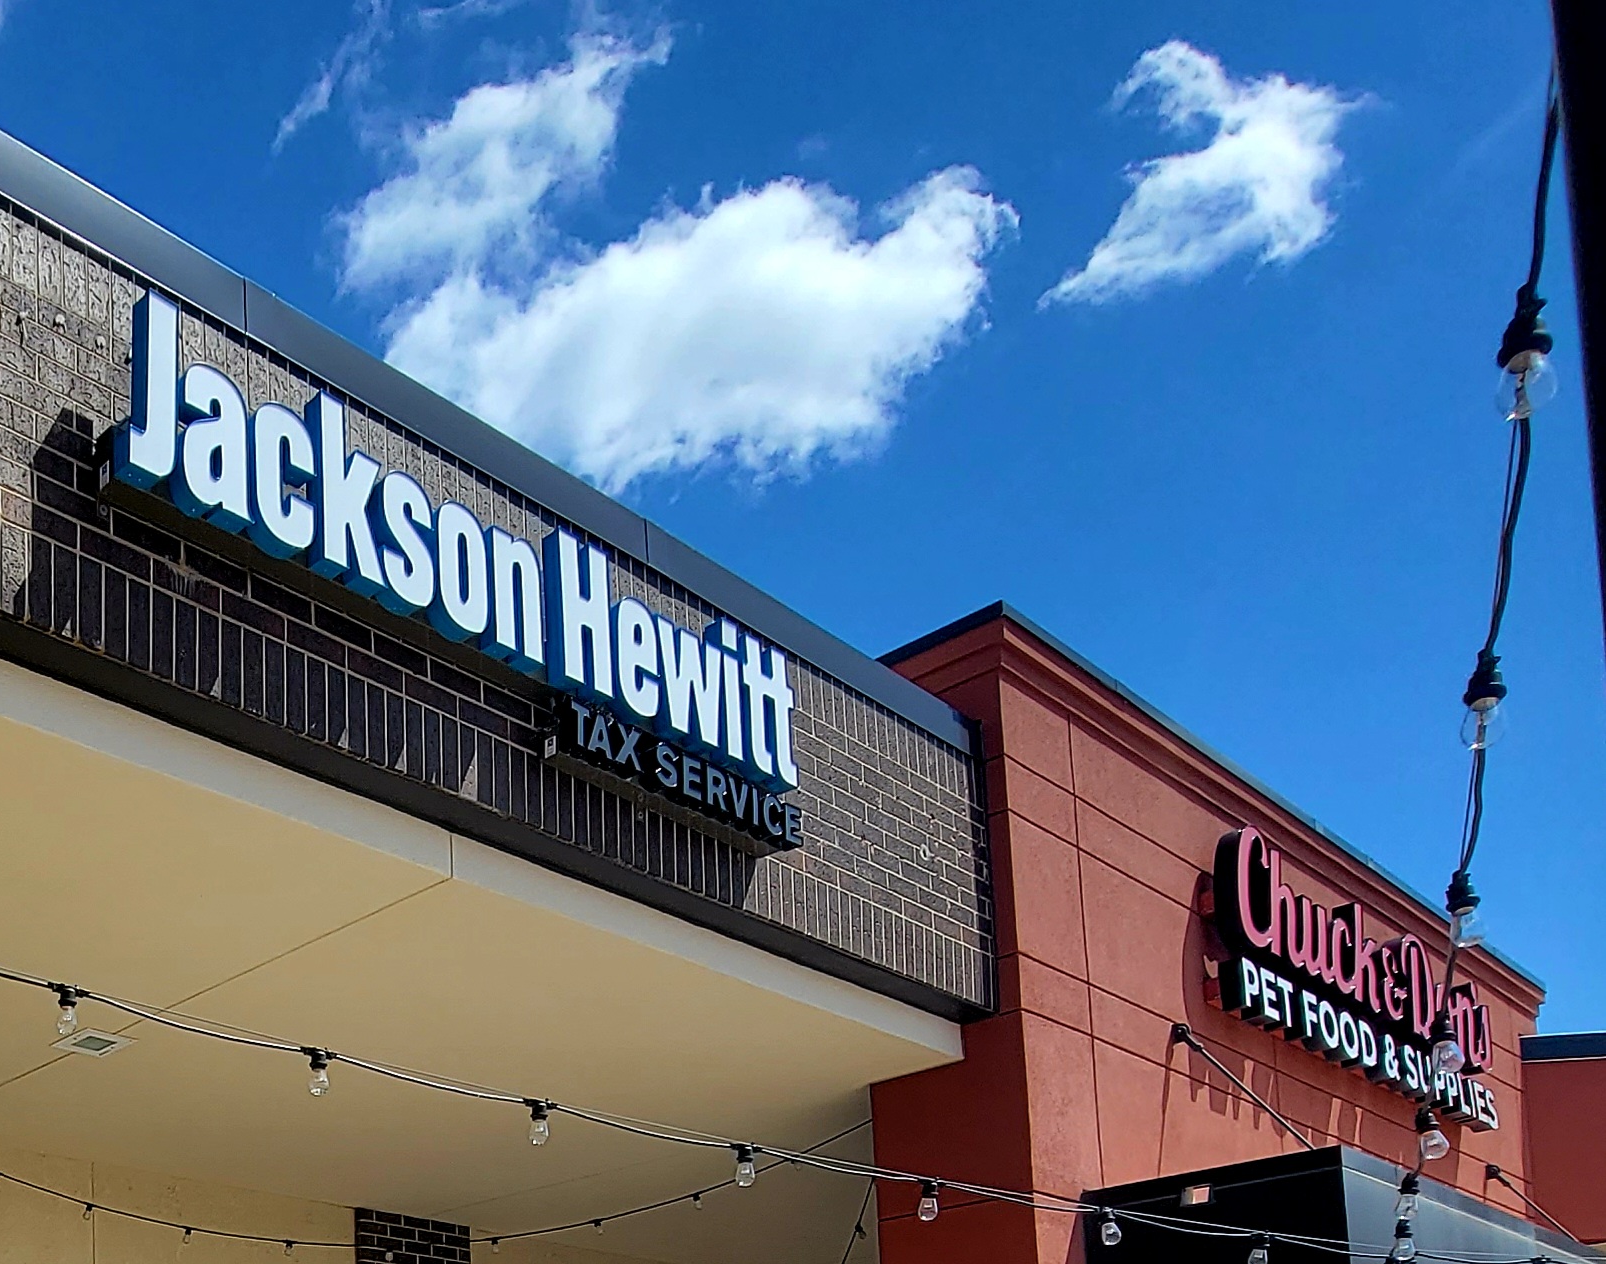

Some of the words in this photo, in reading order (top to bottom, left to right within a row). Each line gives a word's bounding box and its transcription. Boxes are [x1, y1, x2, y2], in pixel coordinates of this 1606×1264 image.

[126, 288, 545, 667] Jackson
[555, 525, 799, 789] Hewitt
[571, 701, 644, 774] TAX
[655, 742, 804, 846] SERVICE
[1237, 825, 1381, 1014] Chuck
[1242, 956, 1294, 1029] PET
[1302, 989, 1377, 1067] FOOD
[1383, 1033, 1402, 1081] &
